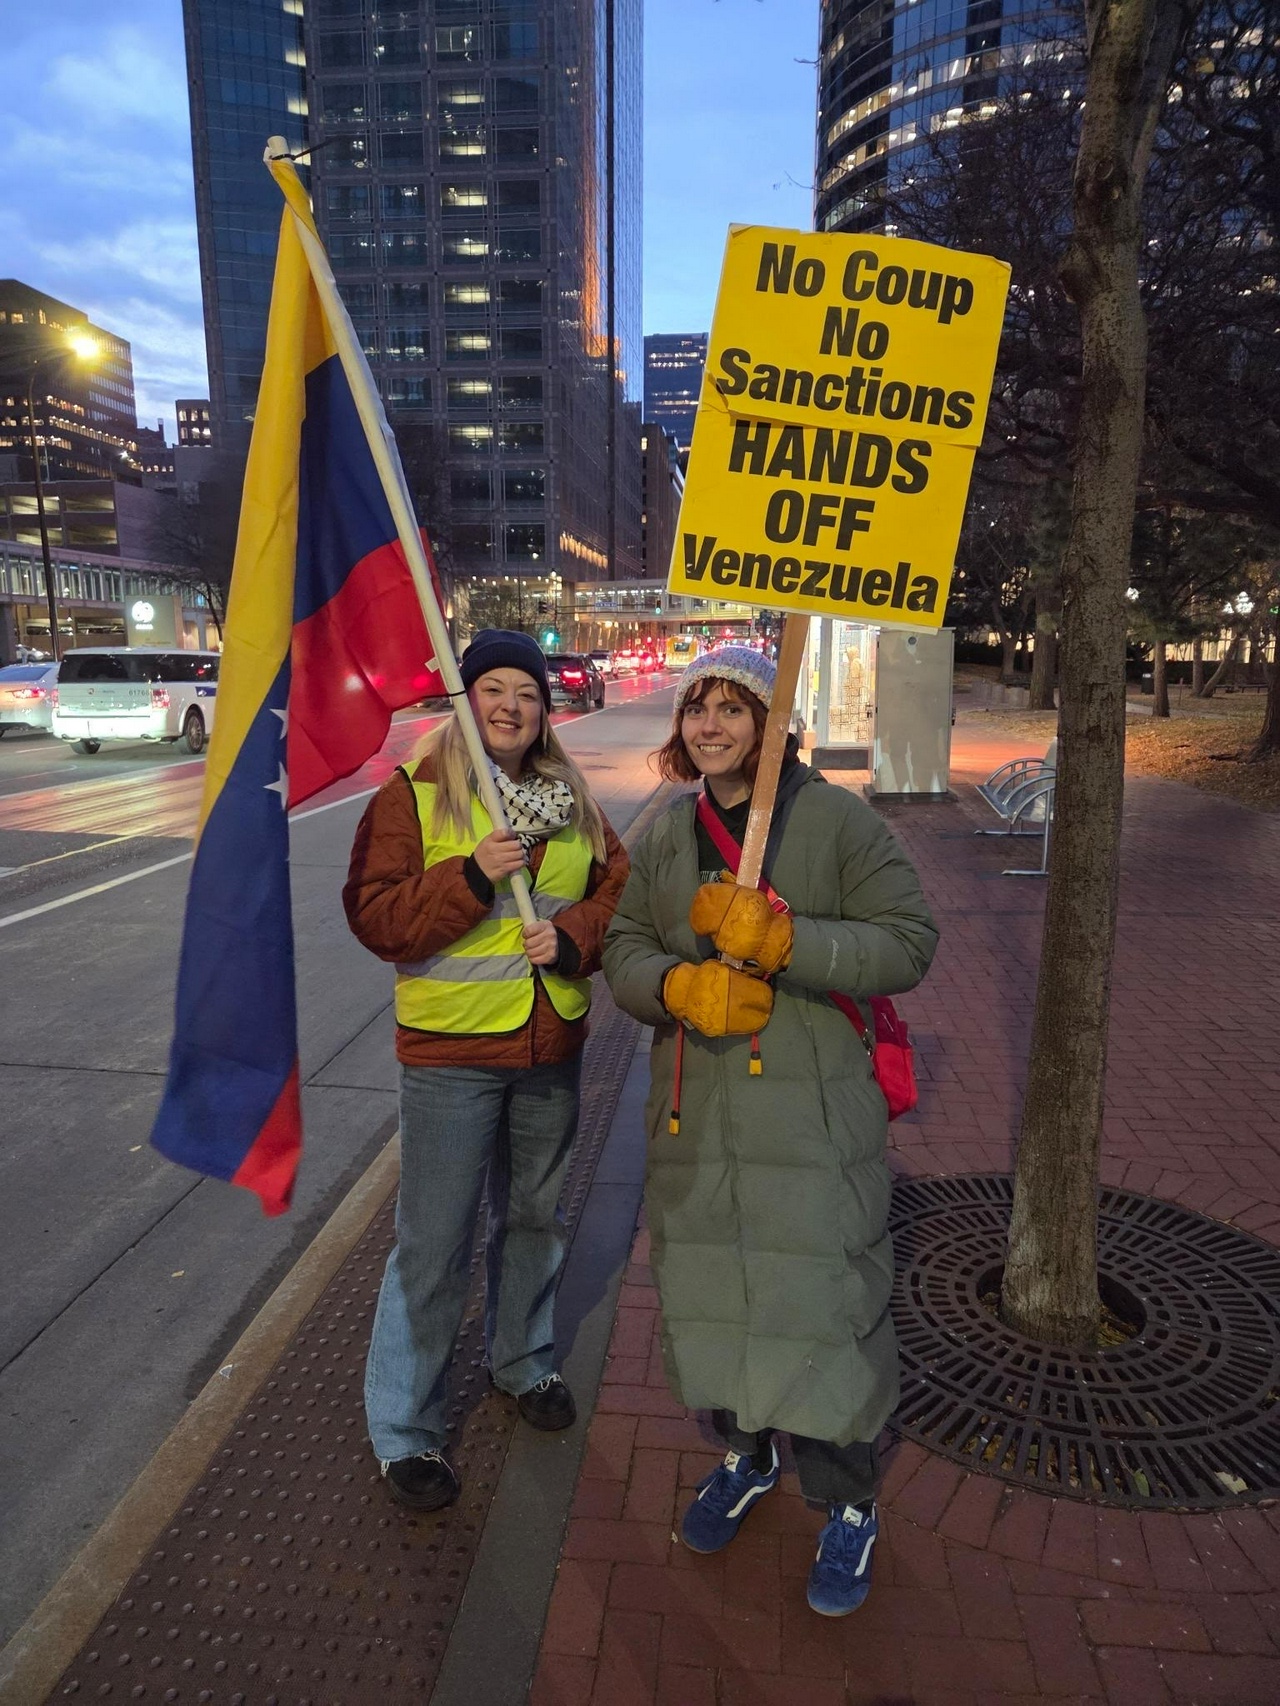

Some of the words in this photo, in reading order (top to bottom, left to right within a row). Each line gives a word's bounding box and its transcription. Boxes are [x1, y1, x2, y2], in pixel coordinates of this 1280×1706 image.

[756, 243, 825, 297] No
[842, 251, 974, 324] Coup
[819, 306, 889, 360] No
[716, 348, 975, 429] Sanctions
[728, 420, 932, 494] HANDS
[765, 490, 875, 551] OFF
[683, 533, 939, 613] Venezuela
